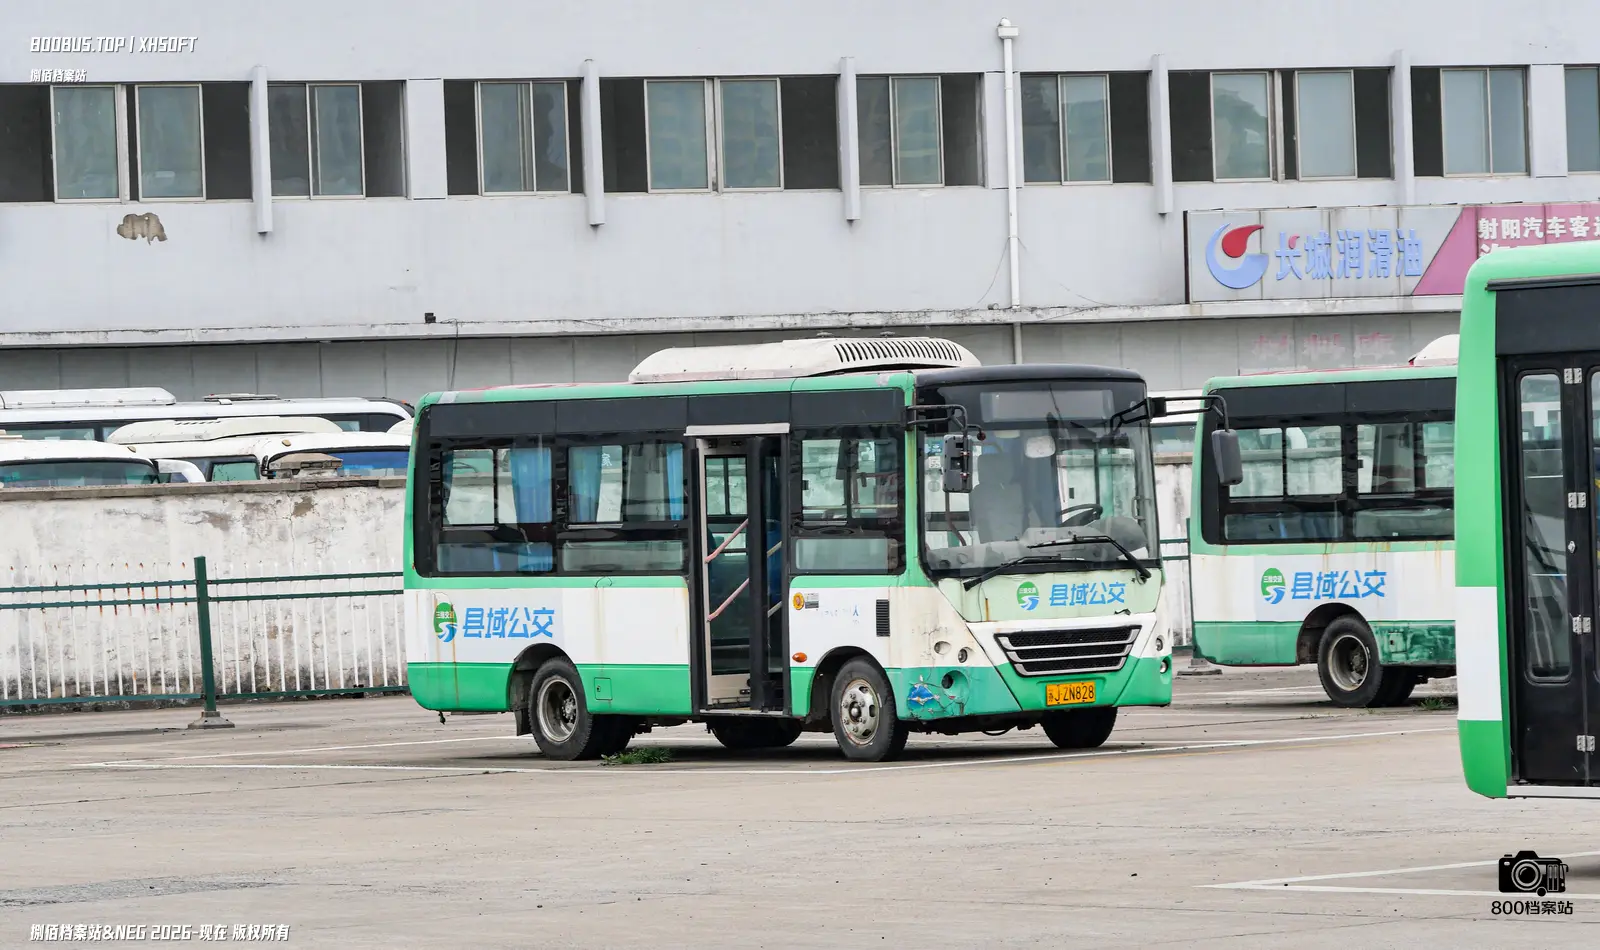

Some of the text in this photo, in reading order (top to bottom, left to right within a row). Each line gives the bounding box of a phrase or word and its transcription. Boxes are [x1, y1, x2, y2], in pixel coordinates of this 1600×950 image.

[1275, 227, 1423, 281] 长城润滑油
[1048, 581, 1126, 607] 县域公交
[1291, 569, 1387, 600] 县域公交
[462, 606, 555, 639] 县域公交
